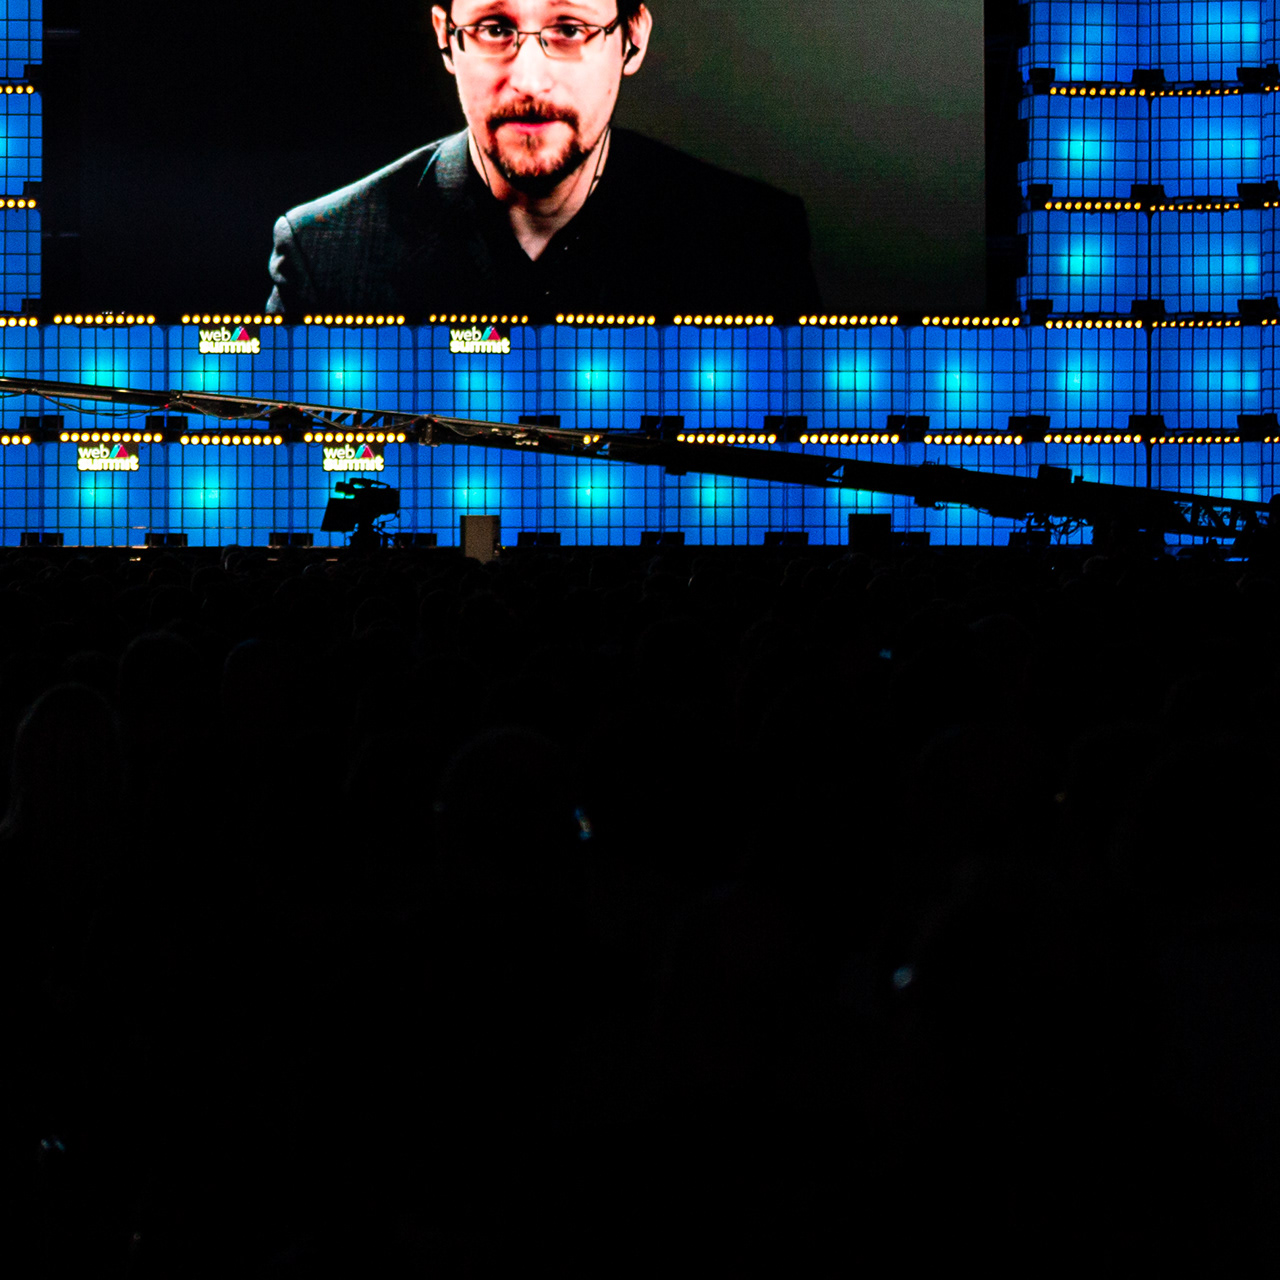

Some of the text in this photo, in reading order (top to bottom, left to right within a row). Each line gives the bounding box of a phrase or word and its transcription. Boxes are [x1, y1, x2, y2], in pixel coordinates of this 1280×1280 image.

[199, 327, 231, 341] web
[450, 326, 482, 341] web
[199, 338, 260, 353] summit
[450, 337, 510, 353] summit
[78, 443, 110, 458] web
[323, 444, 355, 458] web
[78, 454, 139, 470] summit
[323, 455, 384, 471] summit
